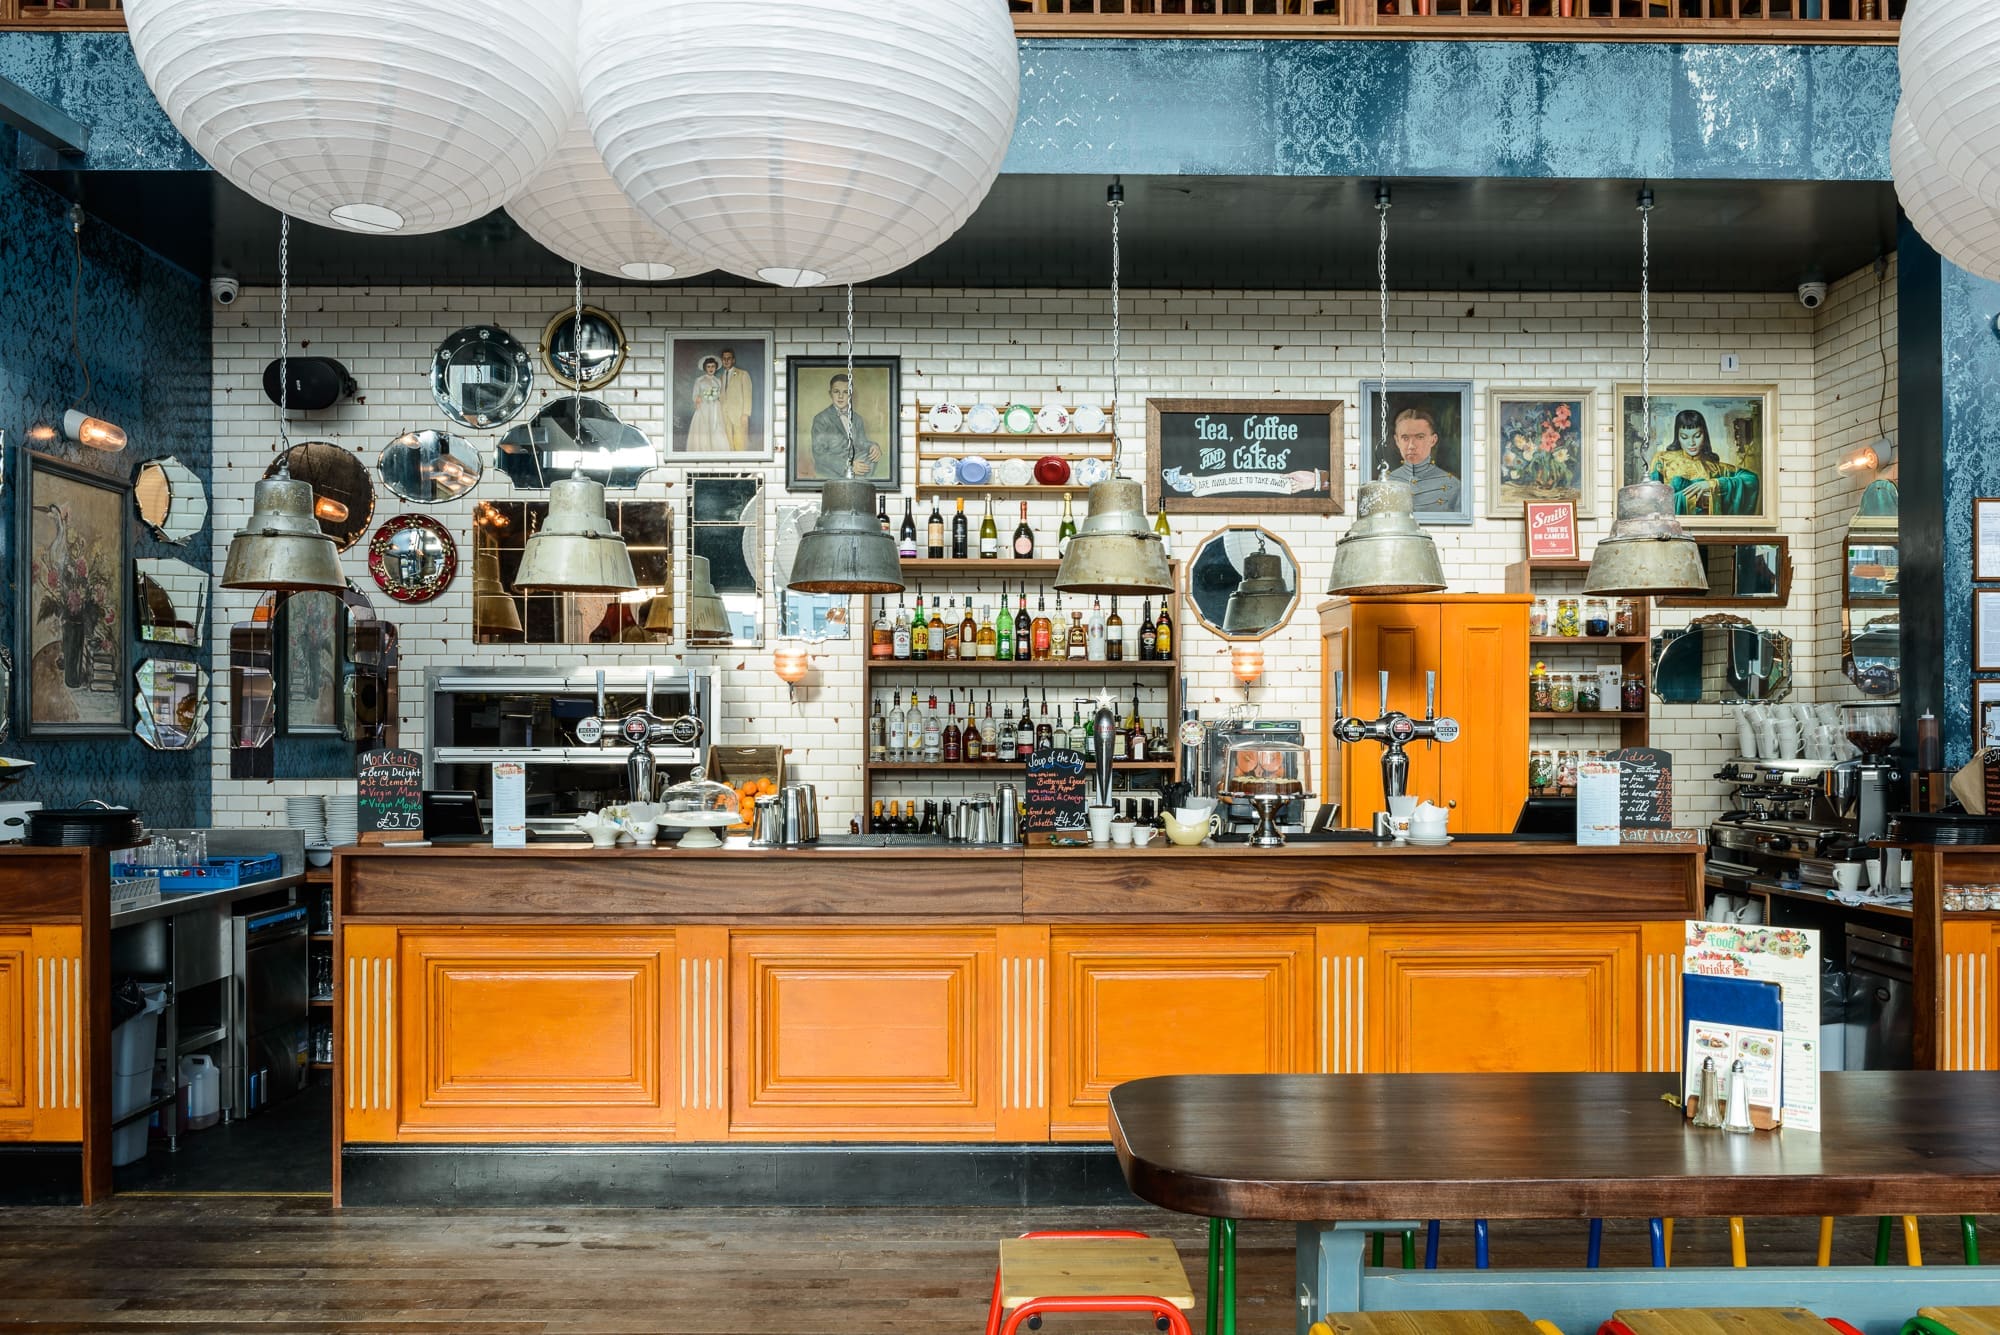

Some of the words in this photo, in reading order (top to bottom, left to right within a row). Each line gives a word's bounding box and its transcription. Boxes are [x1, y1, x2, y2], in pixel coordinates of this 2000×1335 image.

[1195, 415, 1234, 442] Tea,
[1243, 415, 1298, 441] Coffee
[1233, 440, 1291, 470] Cakes
[1532, 507, 1569, 528] Smile
[1029, 753, 1047, 768] Soup
[1047, 750, 1056, 766] of
[1057, 751, 1069, 763] the
[1070, 753, 1084, 775] Day
[1611, 748, 1655, 761] Sides
[368, 767, 389, 780] Berry
[368, 787, 392, 801] Virgin
[396, 786, 421, 805] Mary
[368, 798, 392, 814] Virgin
[395, 797, 422, 812] Mojito
[1054, 810, 1086, 828] £4.25
[1708, 934, 1741, 949] Food
[1698, 961, 1732, 975] Drinks
